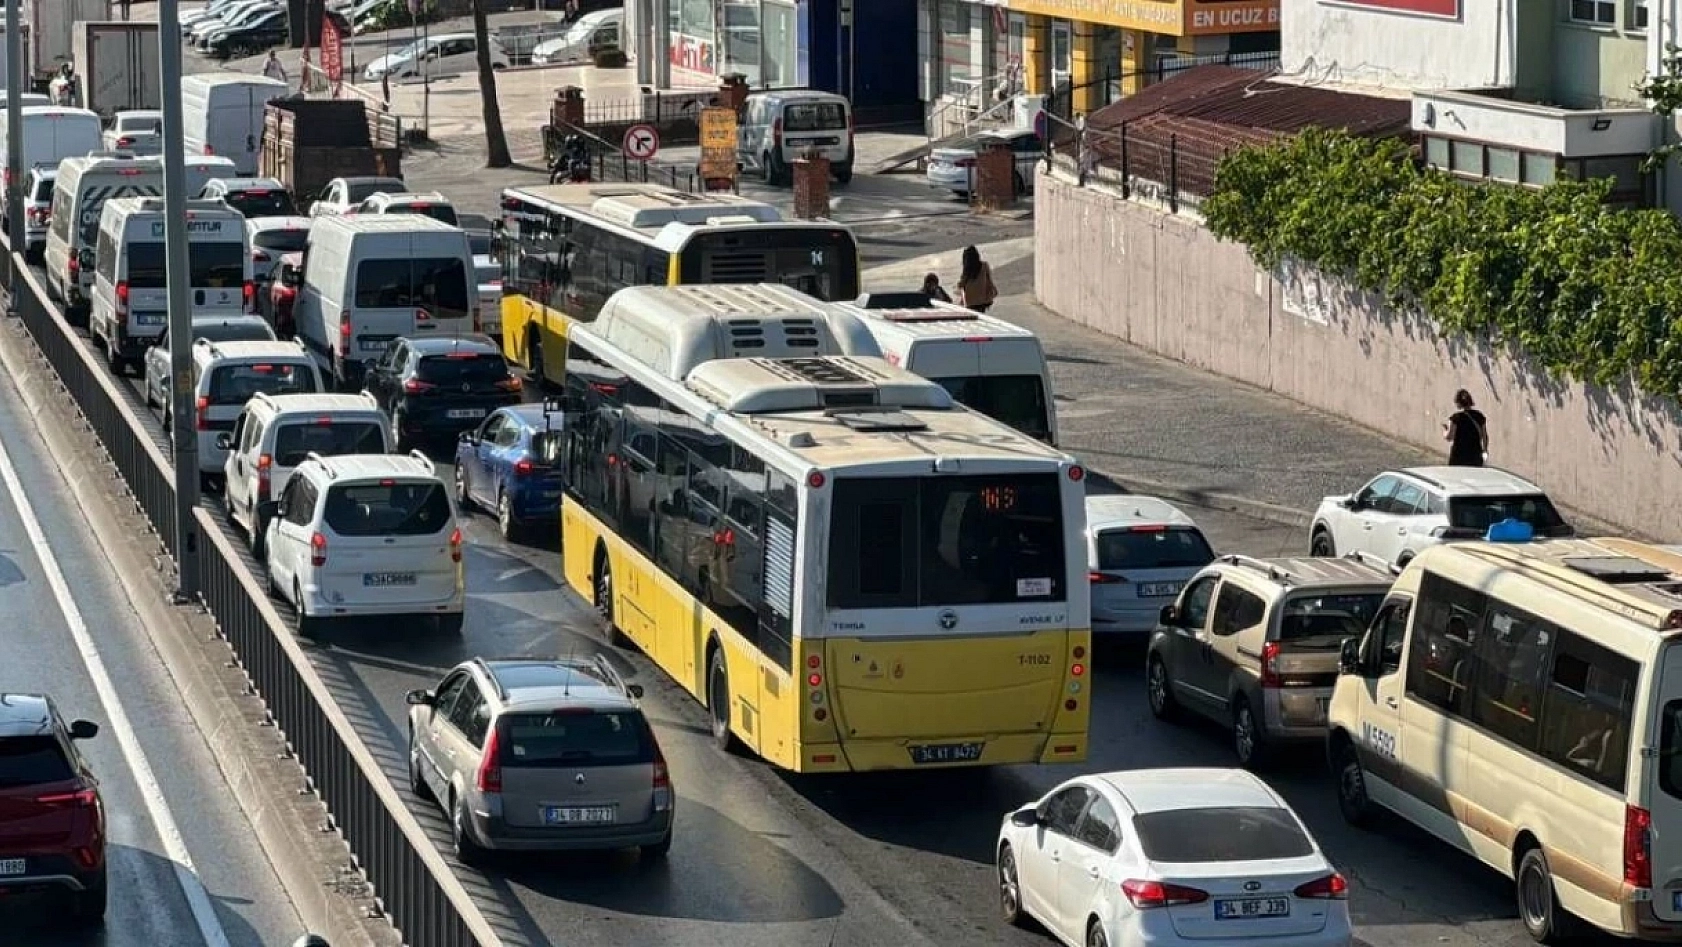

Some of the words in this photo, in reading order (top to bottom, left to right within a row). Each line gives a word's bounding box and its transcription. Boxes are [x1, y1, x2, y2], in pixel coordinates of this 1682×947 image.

[1193, 10, 1214, 27] EN
[1220, 8, 1262, 26] UCUZ
[1268, 7, 1280, 23] B
[1018, 654, 1052, 665] T-1102
[1222, 901, 1236, 914] 34
